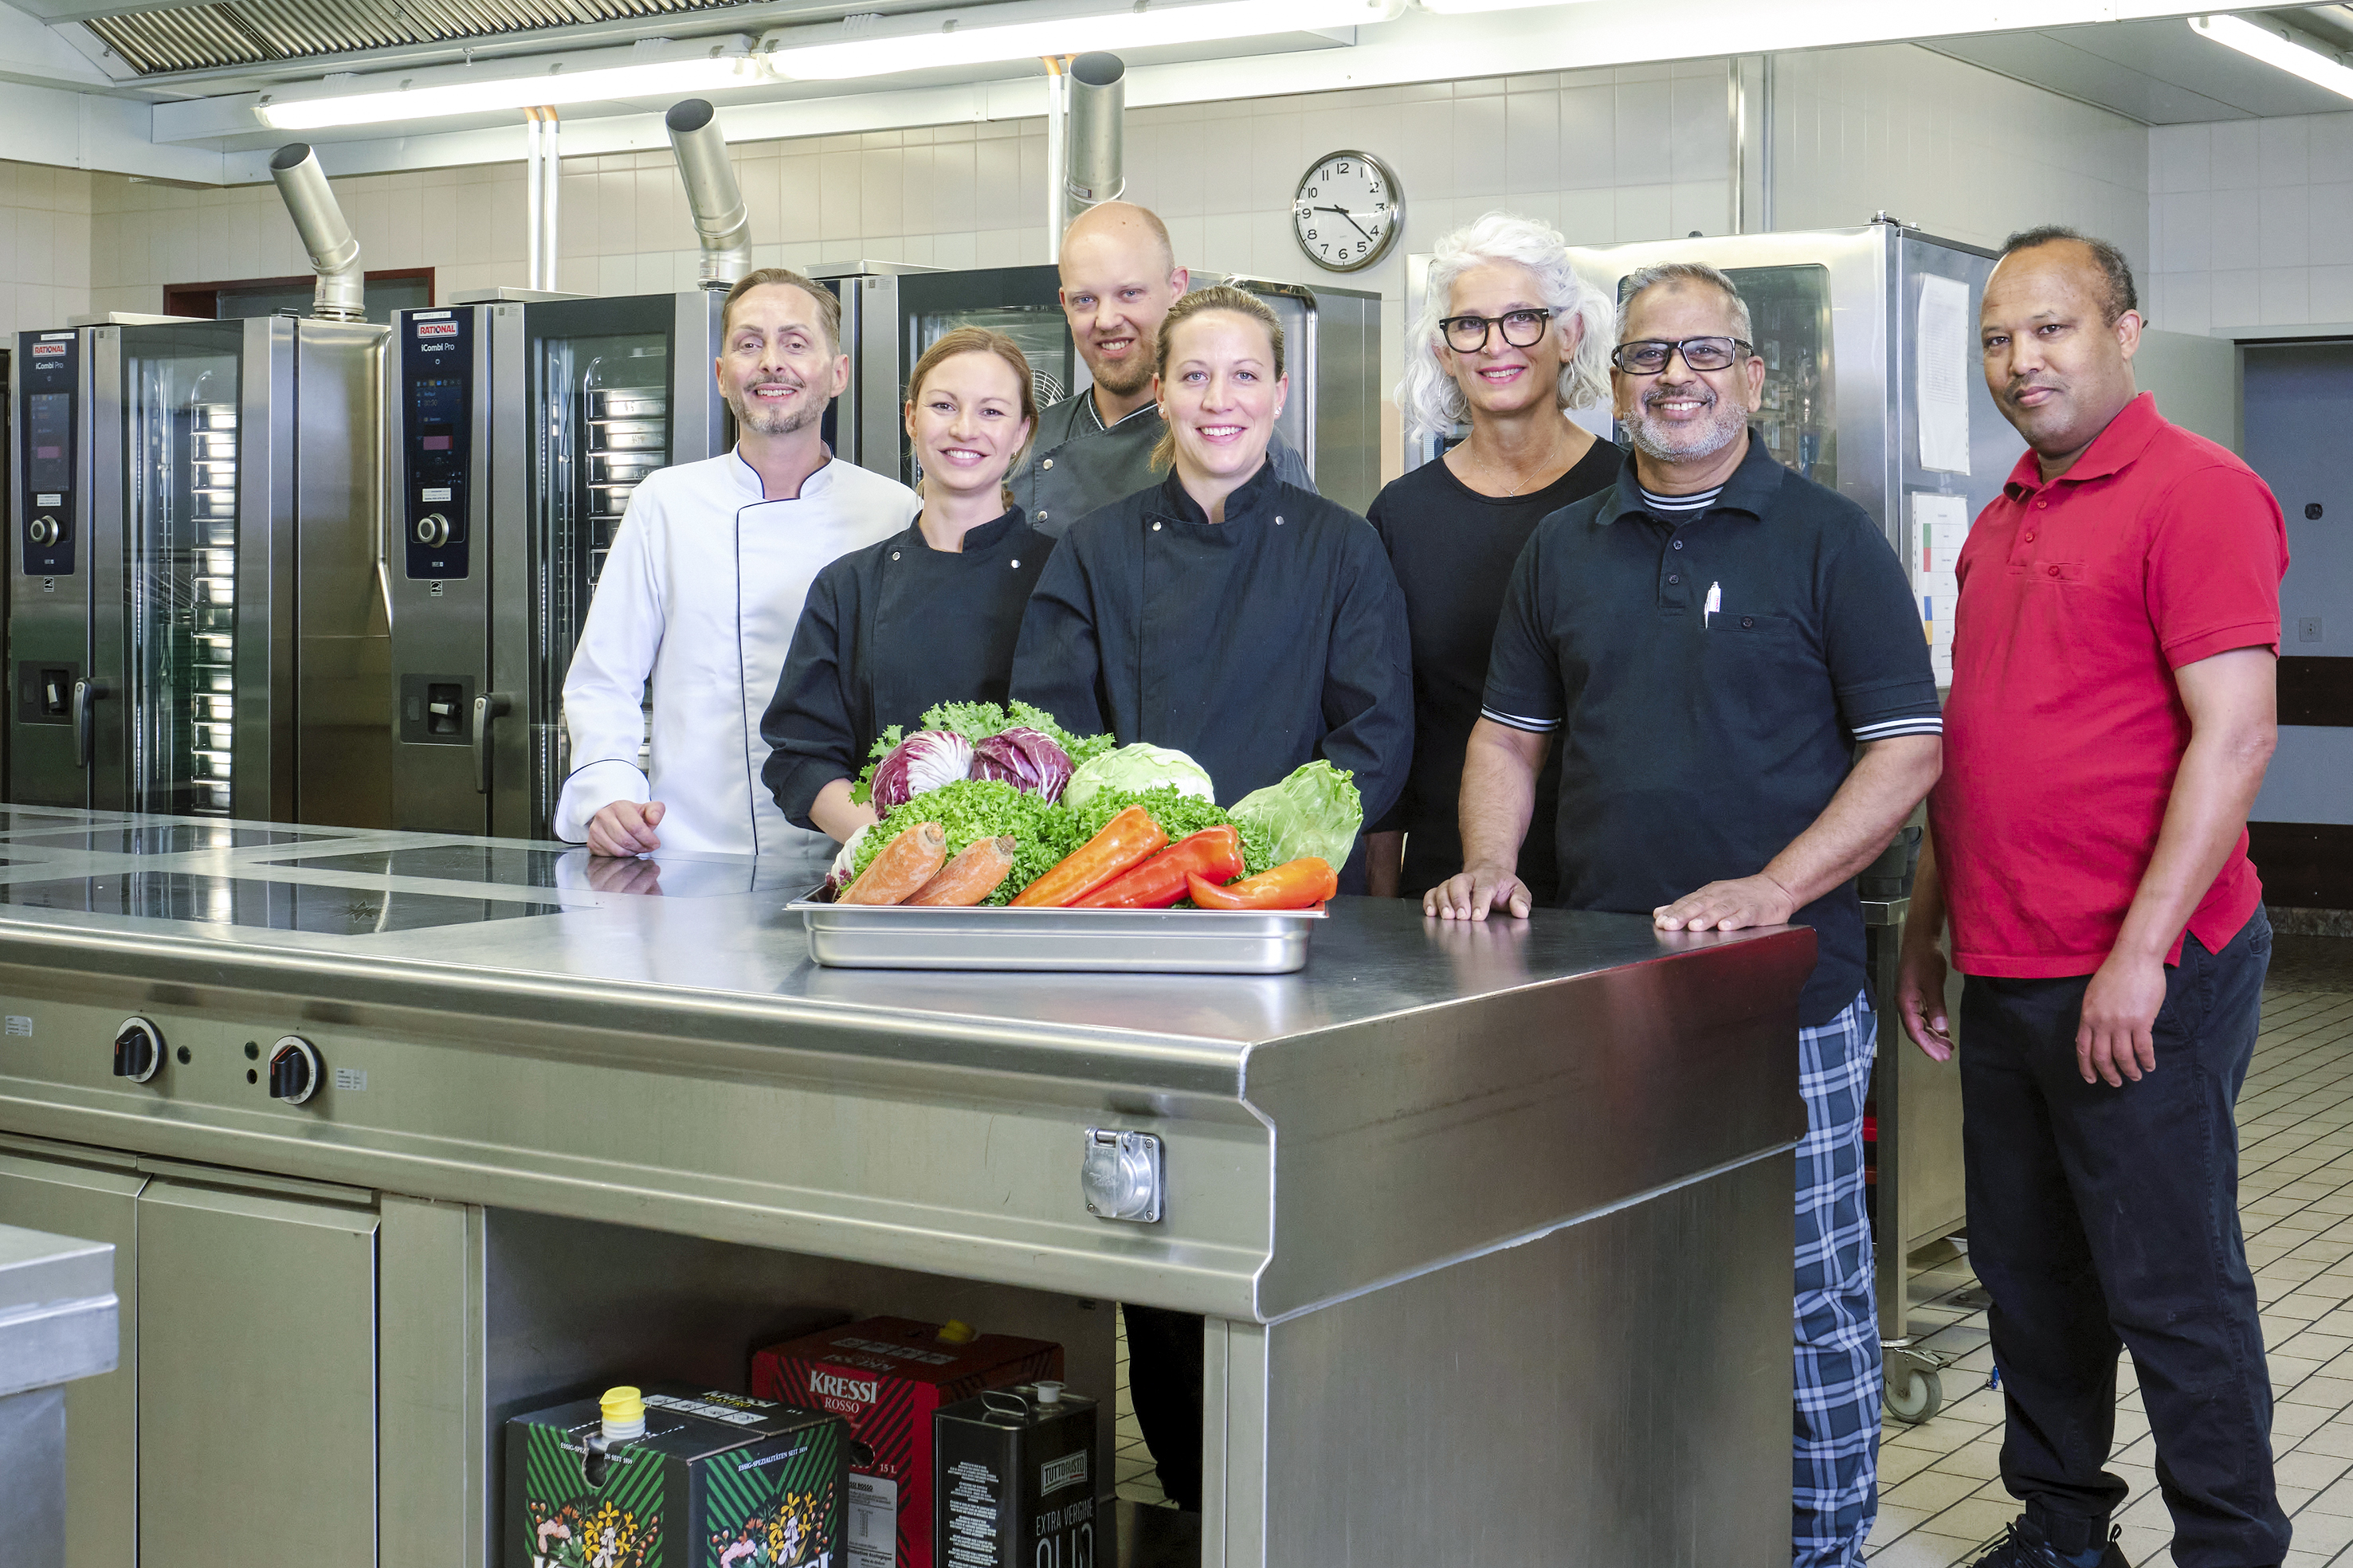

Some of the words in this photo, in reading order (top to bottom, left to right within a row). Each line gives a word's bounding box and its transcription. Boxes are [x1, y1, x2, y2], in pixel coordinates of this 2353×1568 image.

[1336, 163, 1349, 174] 12
[1322, 170, 1329, 181] 11
[1308, 187, 1318, 198] 10
[1369, 181, 1379, 194] 2
[1302, 208, 1312, 219] 9
[1375, 202, 1385, 214] 3
[1308, 229, 1317, 240] 8
[1370, 225, 1379, 236] 4
[1320, 243, 1329, 255] 7
[1356, 241, 1367, 253] 5
[1338, 248, 1348, 260] 6
[420, 324, 456, 335] RATIONAL
[34, 345, 65, 355] RATIONAL
[421, 343, 444, 352] iCombi
[35, 362, 54, 370] iCombi
[809, 1370, 878, 1405] KRESSI
[825, 1396, 860, 1414] ROSSO
[610, 1454, 622, 1464] SEIT
[738, 1450, 788, 1472] ESSIG-SPEZIALITÄTEN
[788, 1447, 798, 1458] SEIT
[880, 1463, 888, 1473] 15
[891, 1464, 897, 1474] L
[1045, 1456, 1084, 1484] TUTTOGUSTO
[857, 1483, 873, 1492] ROSSO
[1036, 1509, 1061, 1537] EXTRA
[1064, 1496, 1094, 1527] VERGINE
